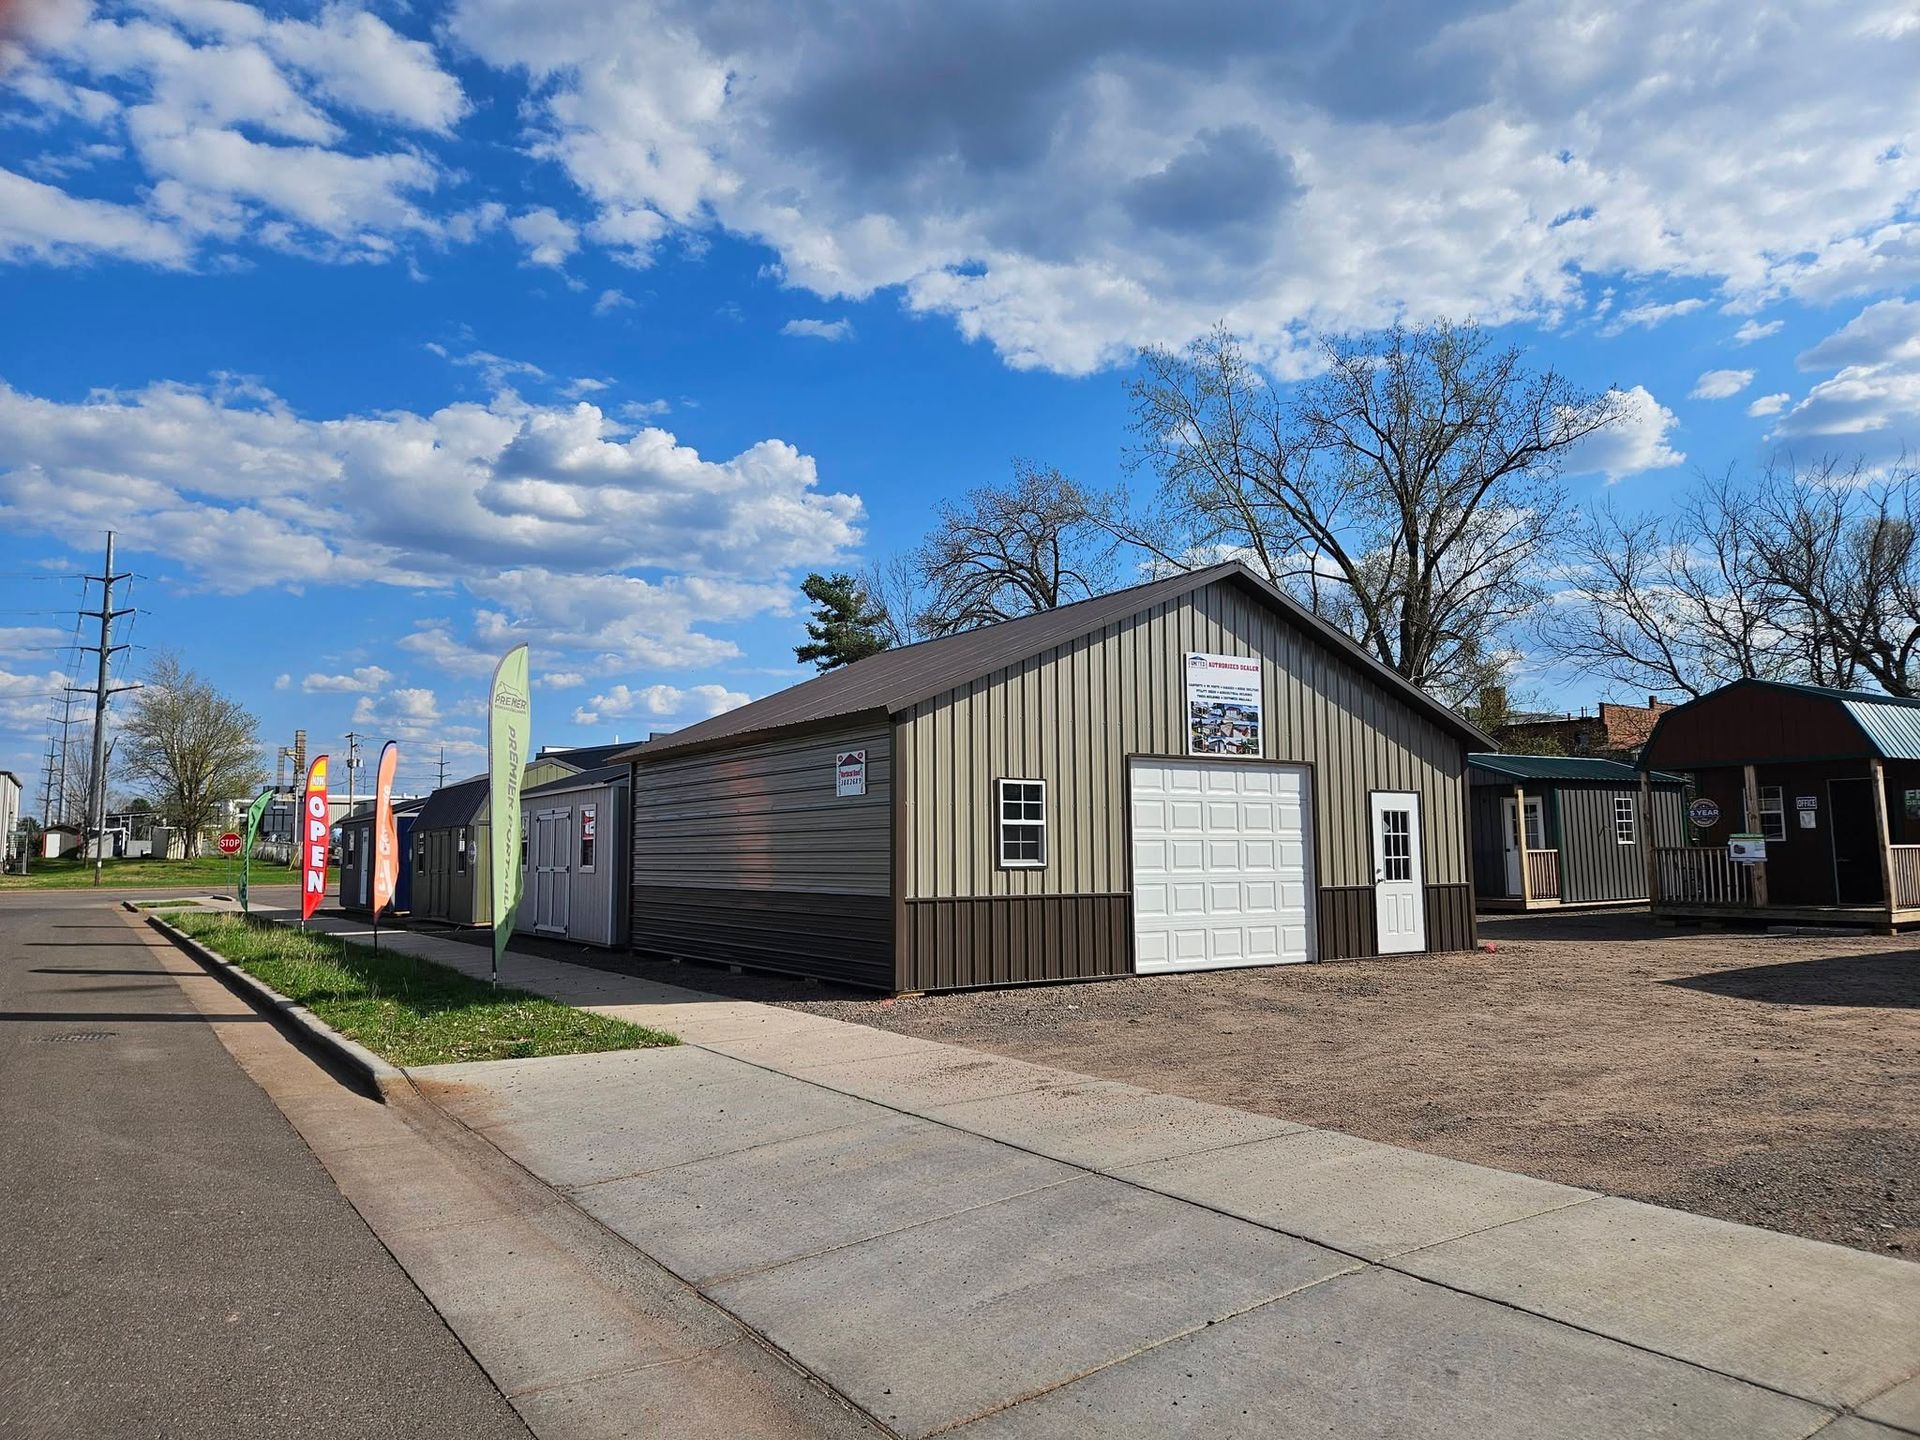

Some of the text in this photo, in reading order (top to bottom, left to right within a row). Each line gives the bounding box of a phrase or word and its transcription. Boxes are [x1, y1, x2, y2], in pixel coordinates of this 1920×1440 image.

[1208, 662, 1239, 670] AUTHORIZED
[1240, 664, 1259, 672] DEALER
[507, 724, 518, 811] PREMIER
[1797, 799, 1816, 807] OFFICE
[219, 838, 240, 848] STOP
[307, 795, 326, 894] OPEN
